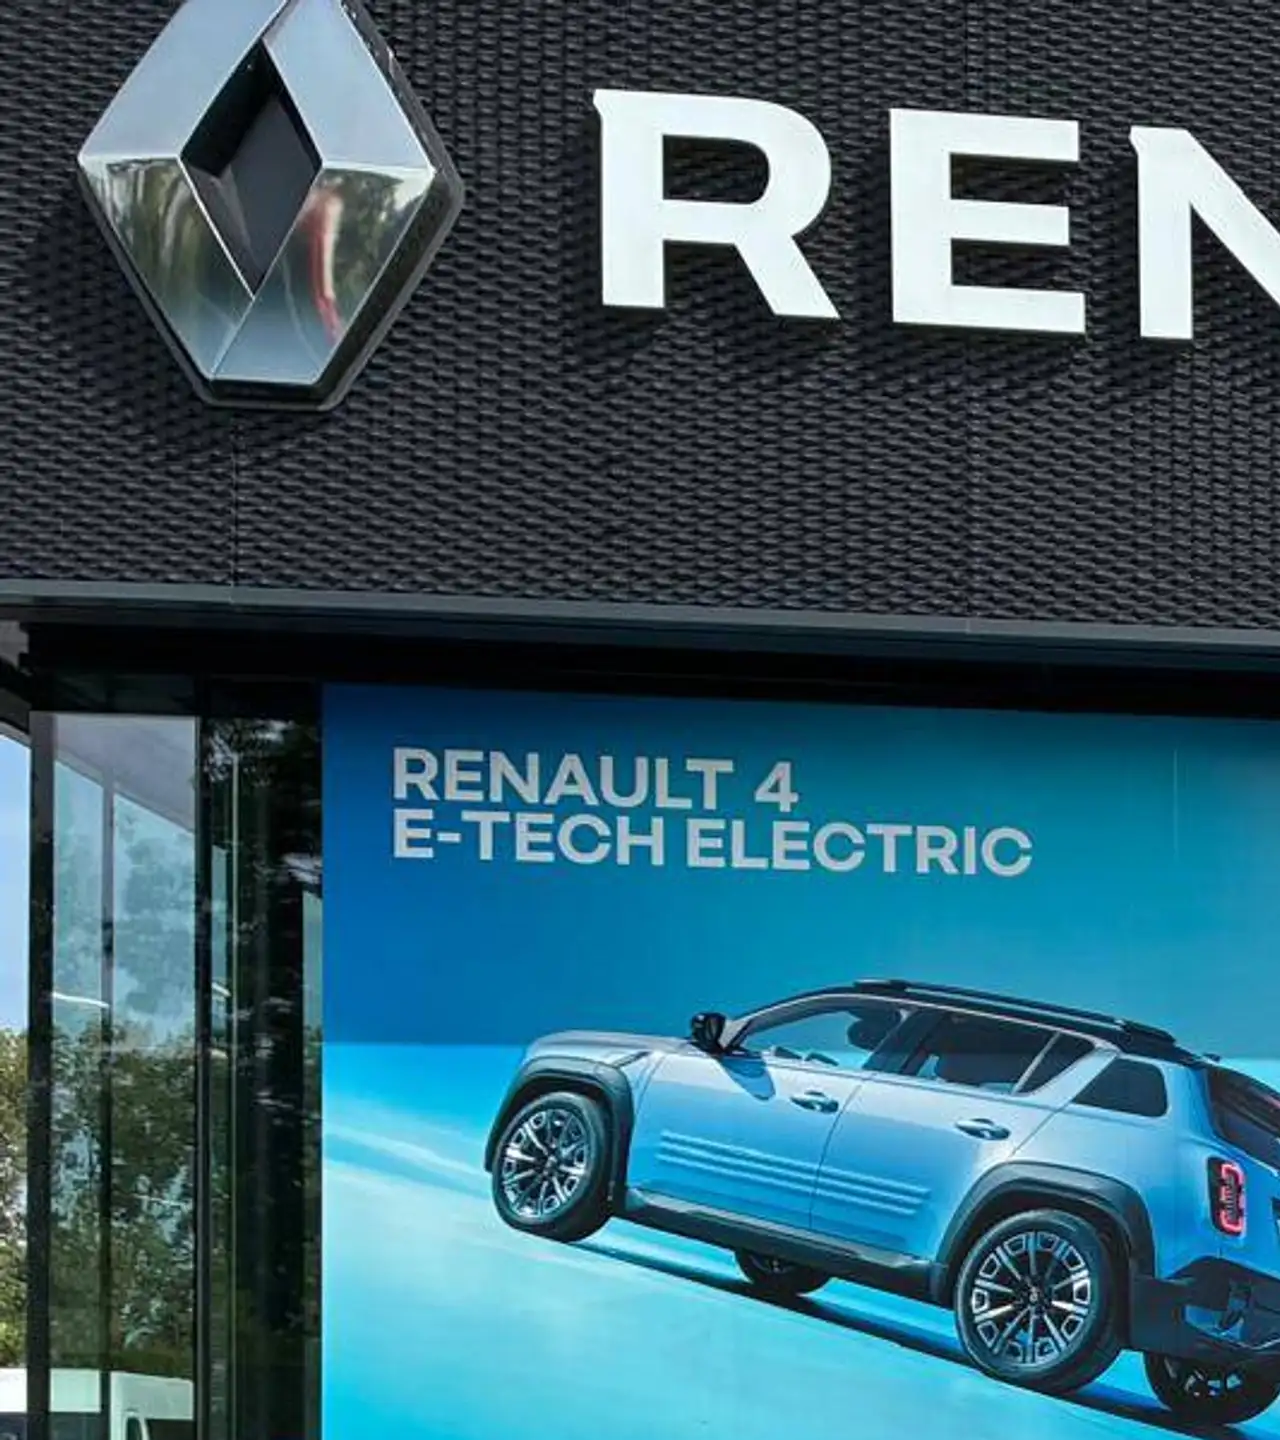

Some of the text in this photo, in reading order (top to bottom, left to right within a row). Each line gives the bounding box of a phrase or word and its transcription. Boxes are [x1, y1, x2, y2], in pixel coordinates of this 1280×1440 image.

[392, 746, 800, 813] RENAULT 4
[392, 807, 1034, 877] E-TECH ELECTRIC
